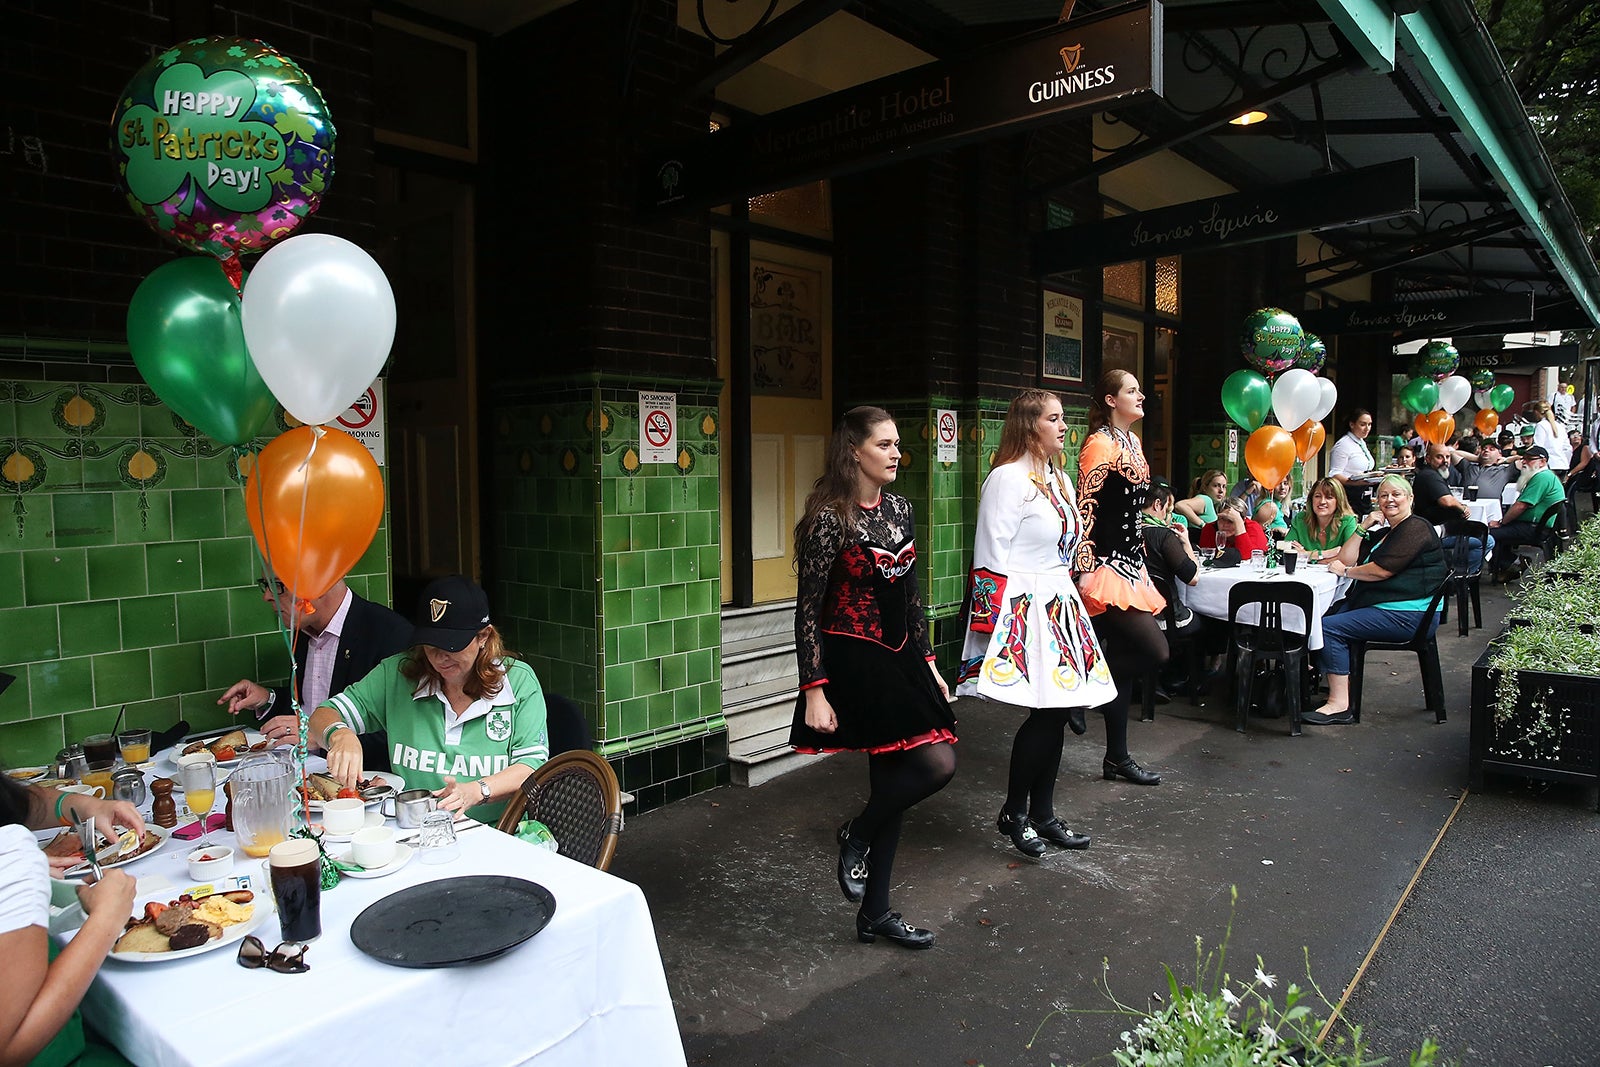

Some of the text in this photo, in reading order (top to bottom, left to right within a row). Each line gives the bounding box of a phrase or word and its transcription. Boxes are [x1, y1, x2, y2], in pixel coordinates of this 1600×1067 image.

[1028, 64, 1115, 104] GUINNESS
[163, 89, 242, 118] Happy
[753, 76, 952, 153] Mercantile Hotel
[123, 117, 279, 160] St. Patrick's
[885, 125, 897, 139] in
[207, 161, 261, 194] Day!
[1130, 201, 1279, 247] James Squire
[759, 313, 814, 345] BAR
[1394, 304, 1448, 328] Squire
[1461, 355, 1499, 366] INNESS
[393, 743, 510, 777] IRELAND
